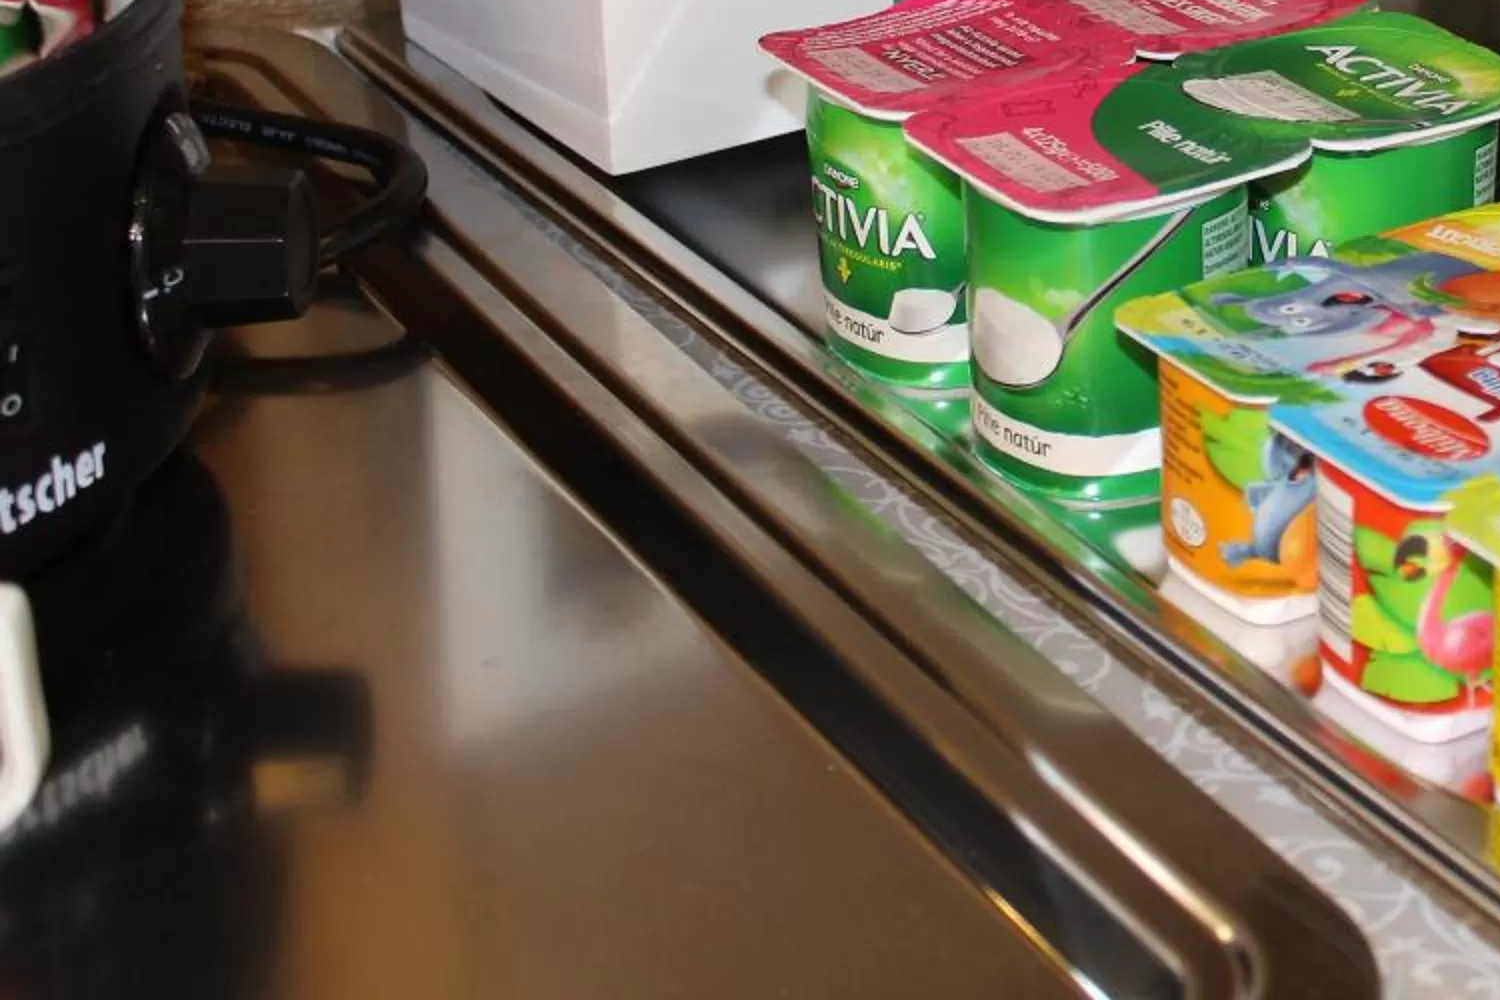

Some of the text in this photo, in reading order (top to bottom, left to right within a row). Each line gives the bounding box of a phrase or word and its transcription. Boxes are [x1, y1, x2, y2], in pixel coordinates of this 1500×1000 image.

[1305, 45, 1477, 115] ACTIVIA
[811, 176, 937, 260] CTIVIA
[844, 315, 885, 343] natúr
[1003, 427, 1053, 457] natúr
